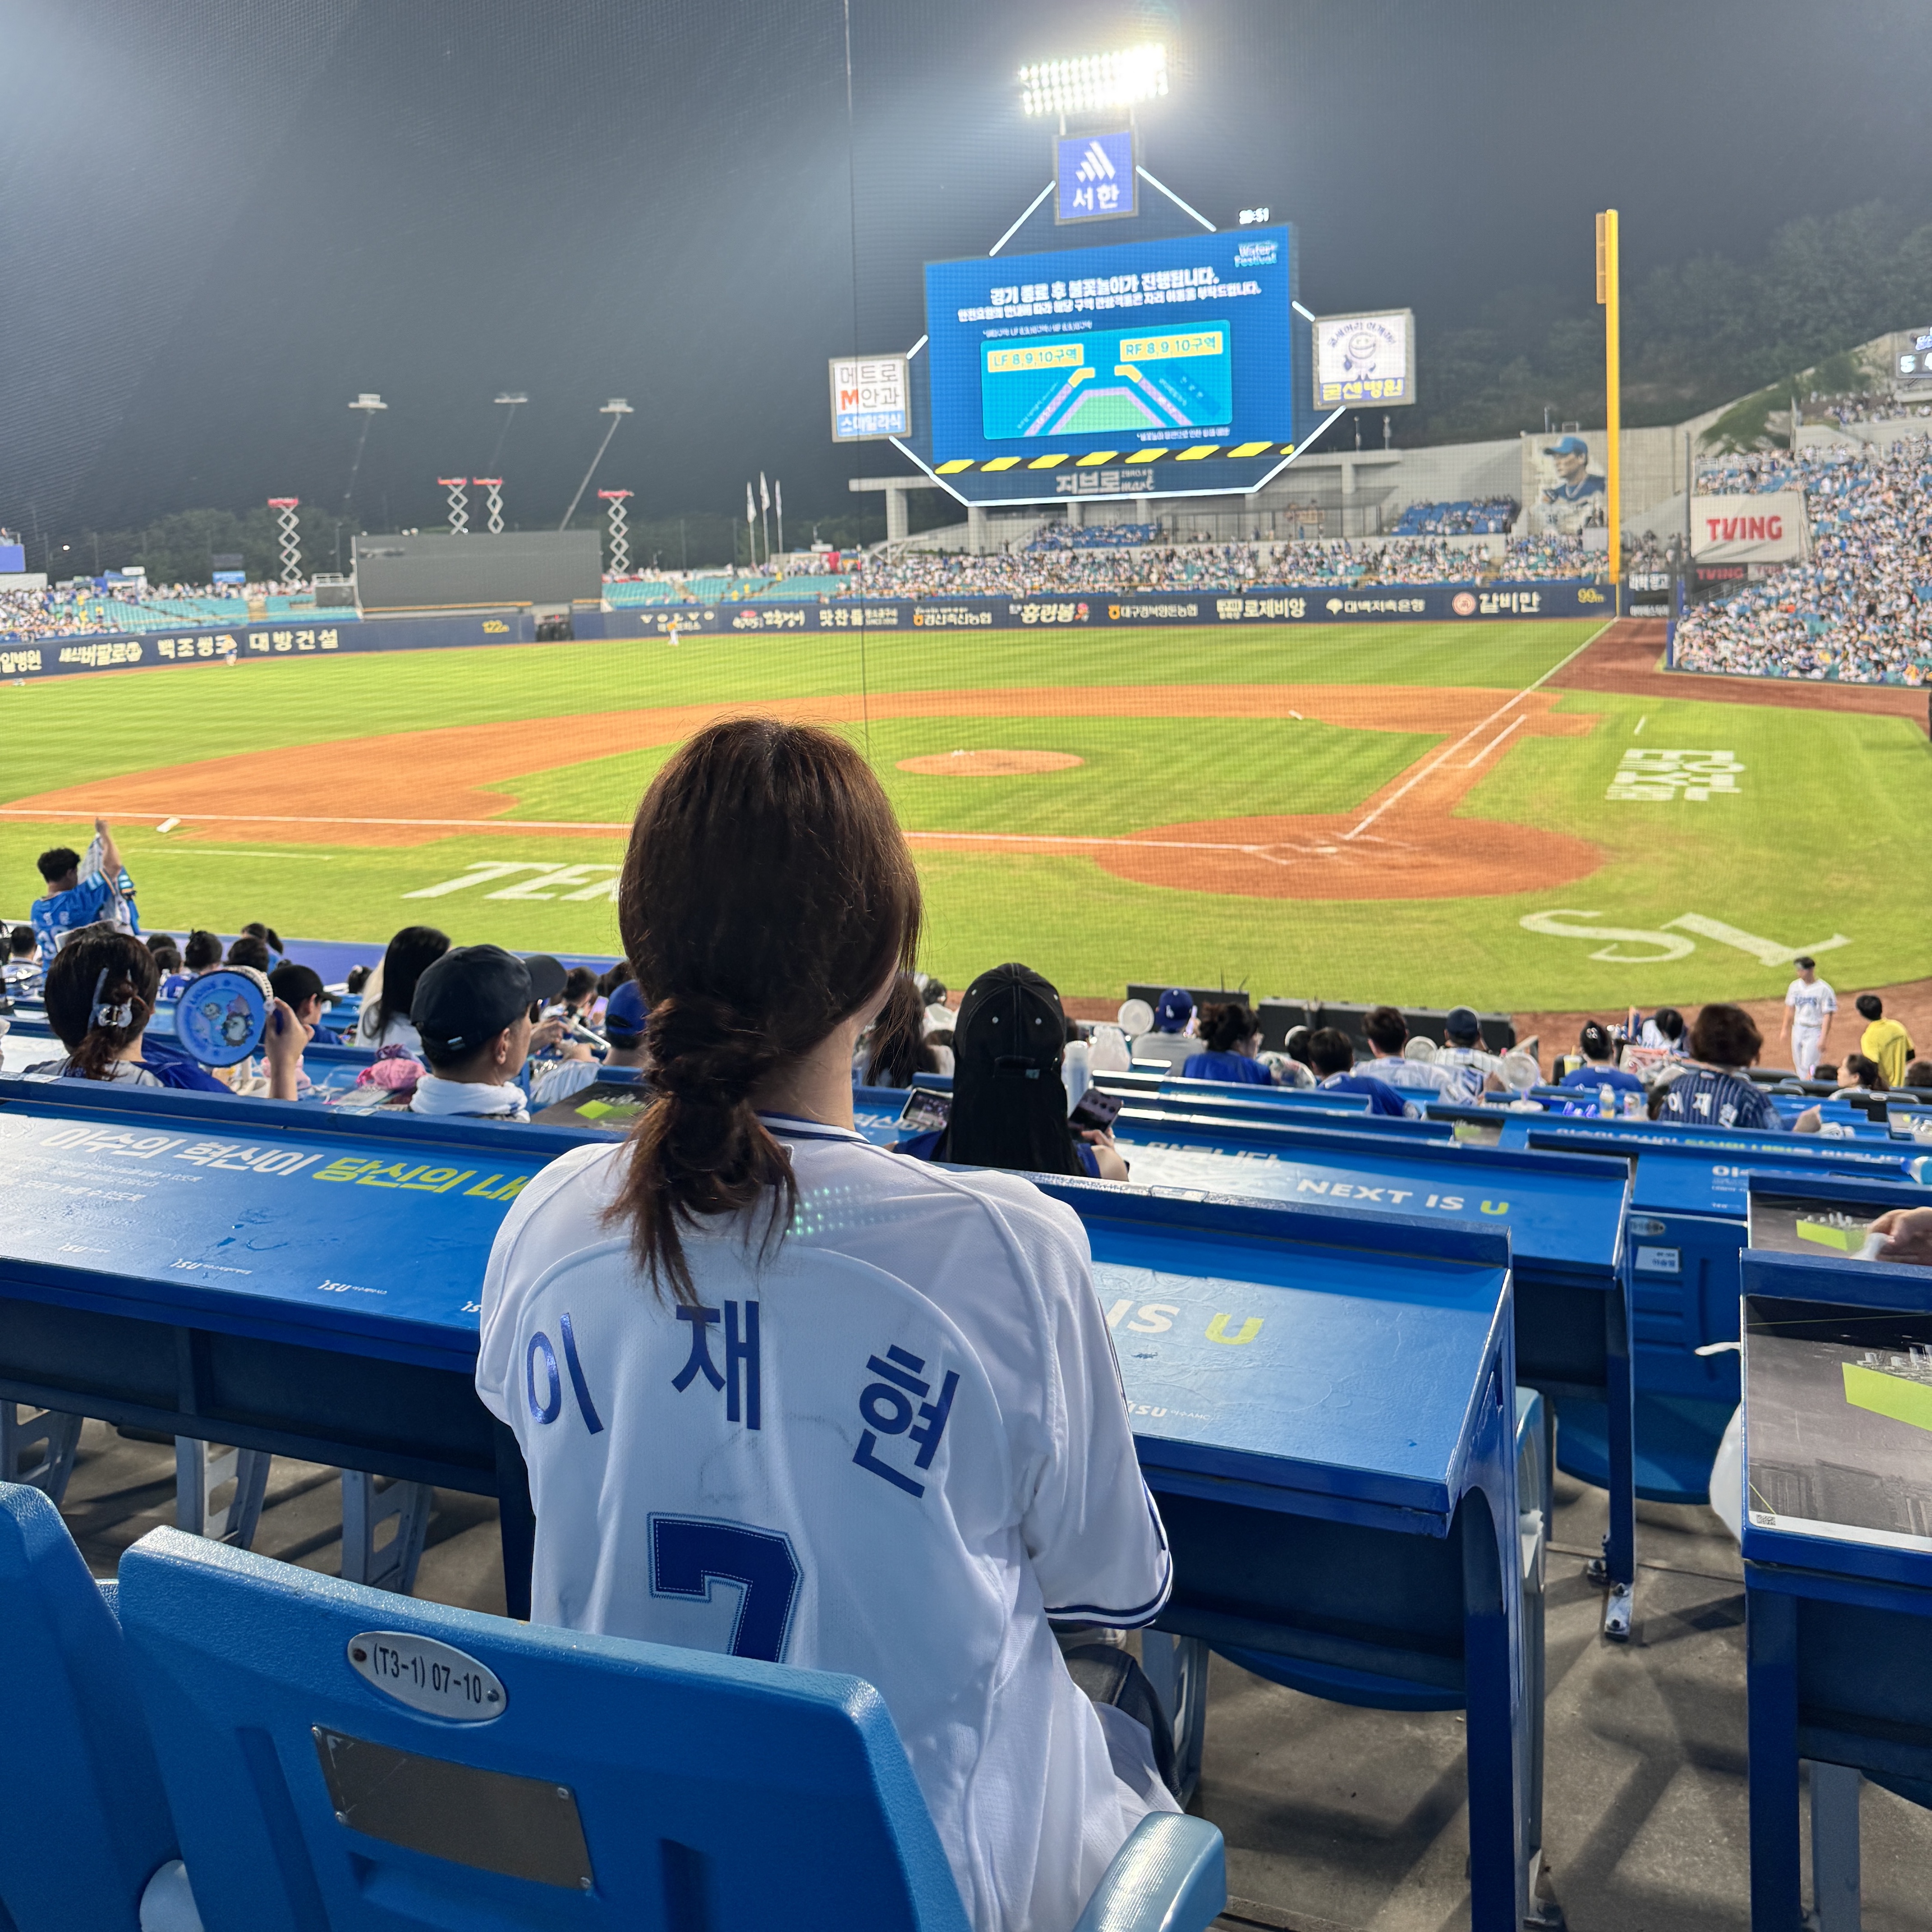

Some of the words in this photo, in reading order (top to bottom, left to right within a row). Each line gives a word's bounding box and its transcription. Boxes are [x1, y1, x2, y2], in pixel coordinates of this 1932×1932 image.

[1073, 184, 1120, 211] 서한
[994, 355, 1008, 366] LF
[1126, 343, 1143, 355] RF
[840, 363, 898, 386] 메트로
[1706, 515, 1782, 542] TVING
[1697, 566, 1744, 580] TVING
[1578, 588, 1604, 603] 99m
[1243, 598, 1306, 618] 로제비앙
[249, 629, 338, 652] 대방건설
[0, 649, 42, 673] 일병원
[40, 1127, 187, 1159] 이수의
[174, 1142, 324, 1175] 혁신이
[313, 1157, 477, 1193] 당신의
[1297, 1178, 1413, 1204] NEXT
[1425, 1193, 1465, 1210] IS
[1480, 1201, 1509, 1216] U
[1107, 1299, 1179, 1333] IS
[1204, 1313, 1265, 1345] U
[647, 1511, 805, 1664] 7
[374, 1643, 425, 1688] (T3-1)
[433, 1662, 482, 1703] 07-10
